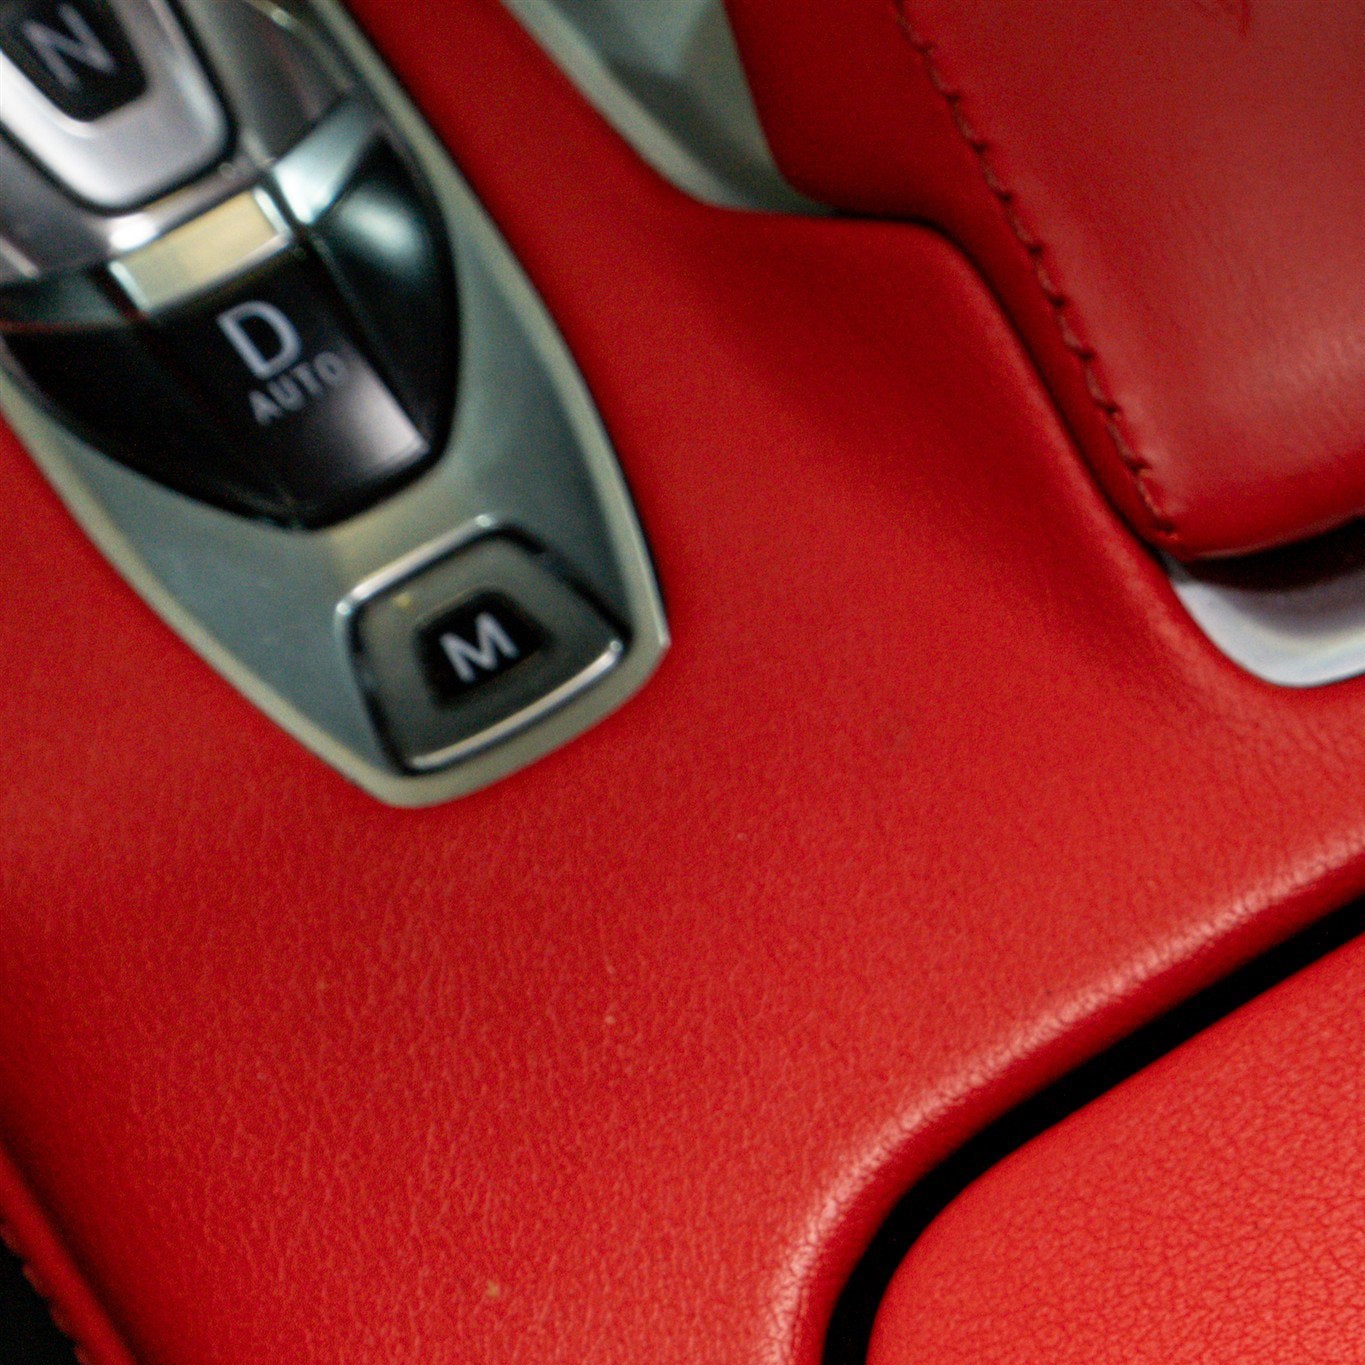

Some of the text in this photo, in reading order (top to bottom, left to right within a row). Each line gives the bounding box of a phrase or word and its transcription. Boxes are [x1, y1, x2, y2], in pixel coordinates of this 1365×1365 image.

[24, 3, 114, 91] N
[216, 300, 301, 380] D
[249, 351, 347, 424] AUTO
[439, 612, 518, 682] M
